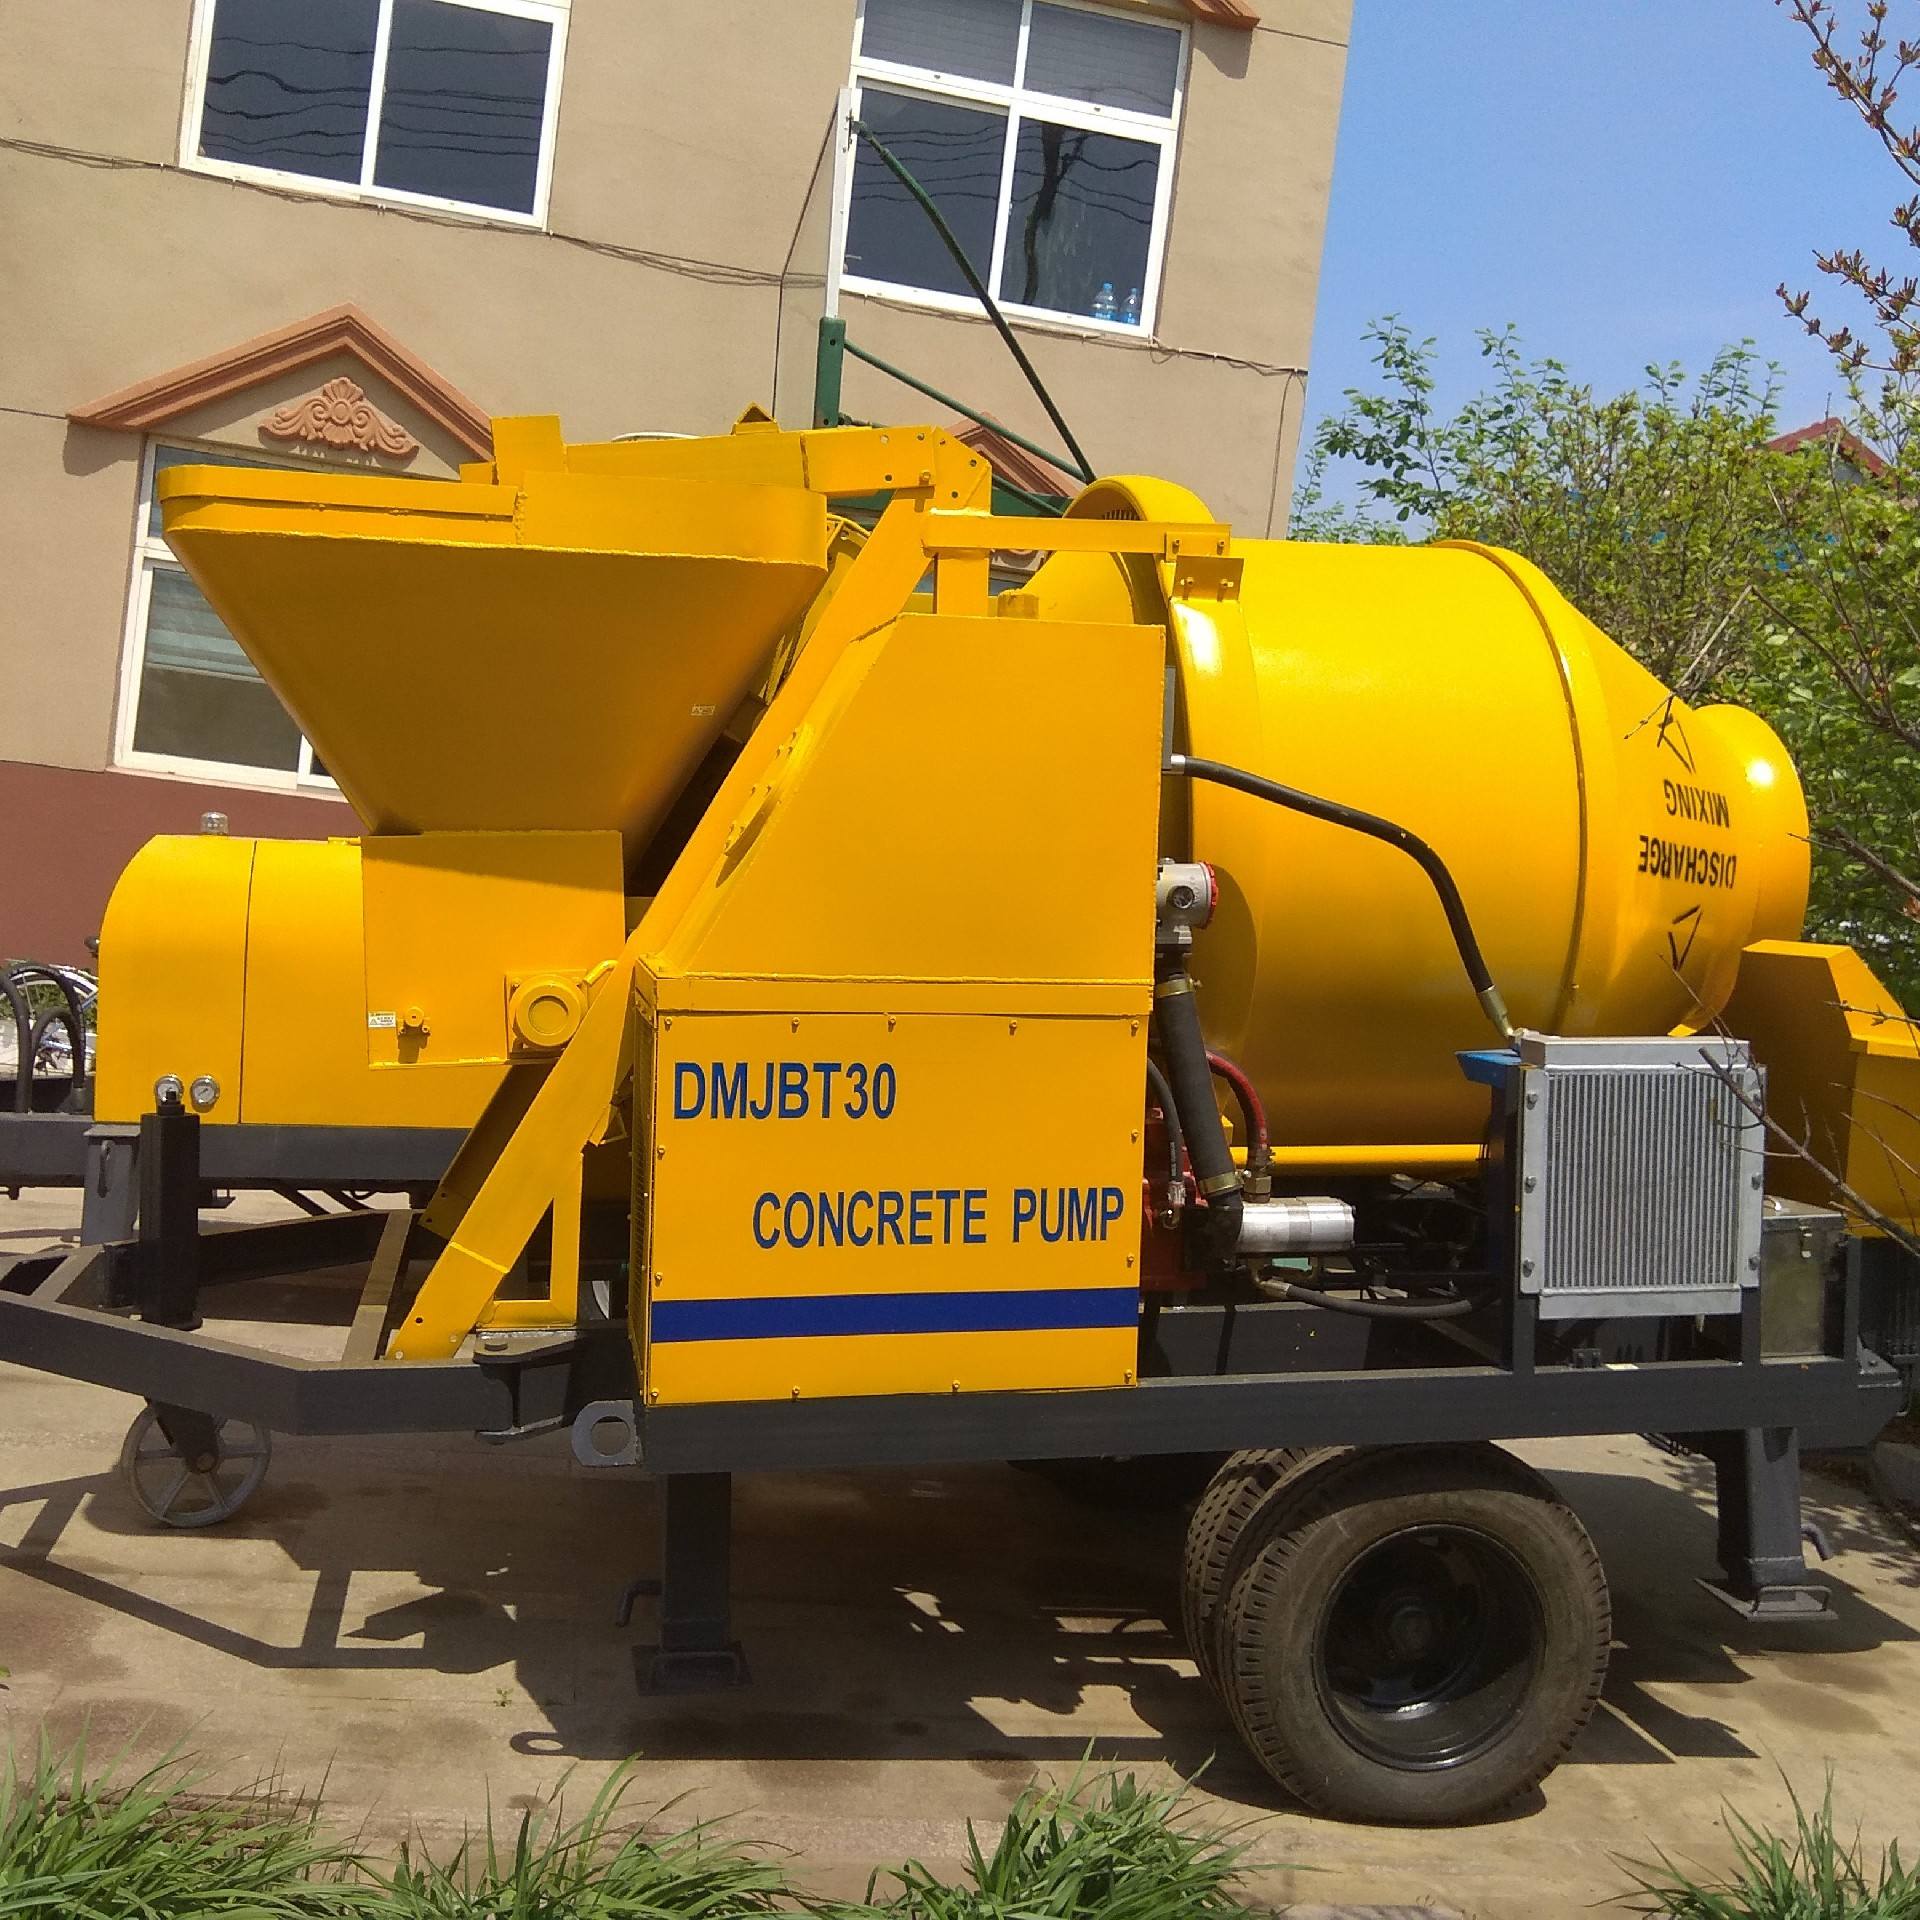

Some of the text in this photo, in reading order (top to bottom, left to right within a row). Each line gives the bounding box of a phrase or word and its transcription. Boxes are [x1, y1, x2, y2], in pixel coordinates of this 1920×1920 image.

[1664, 778, 1729, 828] MIXING
[1638, 834, 1737, 889] DISCHARGE
[673, 1061, 897, 1120] DMJBT30
[752, 1187, 1124, 1249] CONCRETE PUMP
